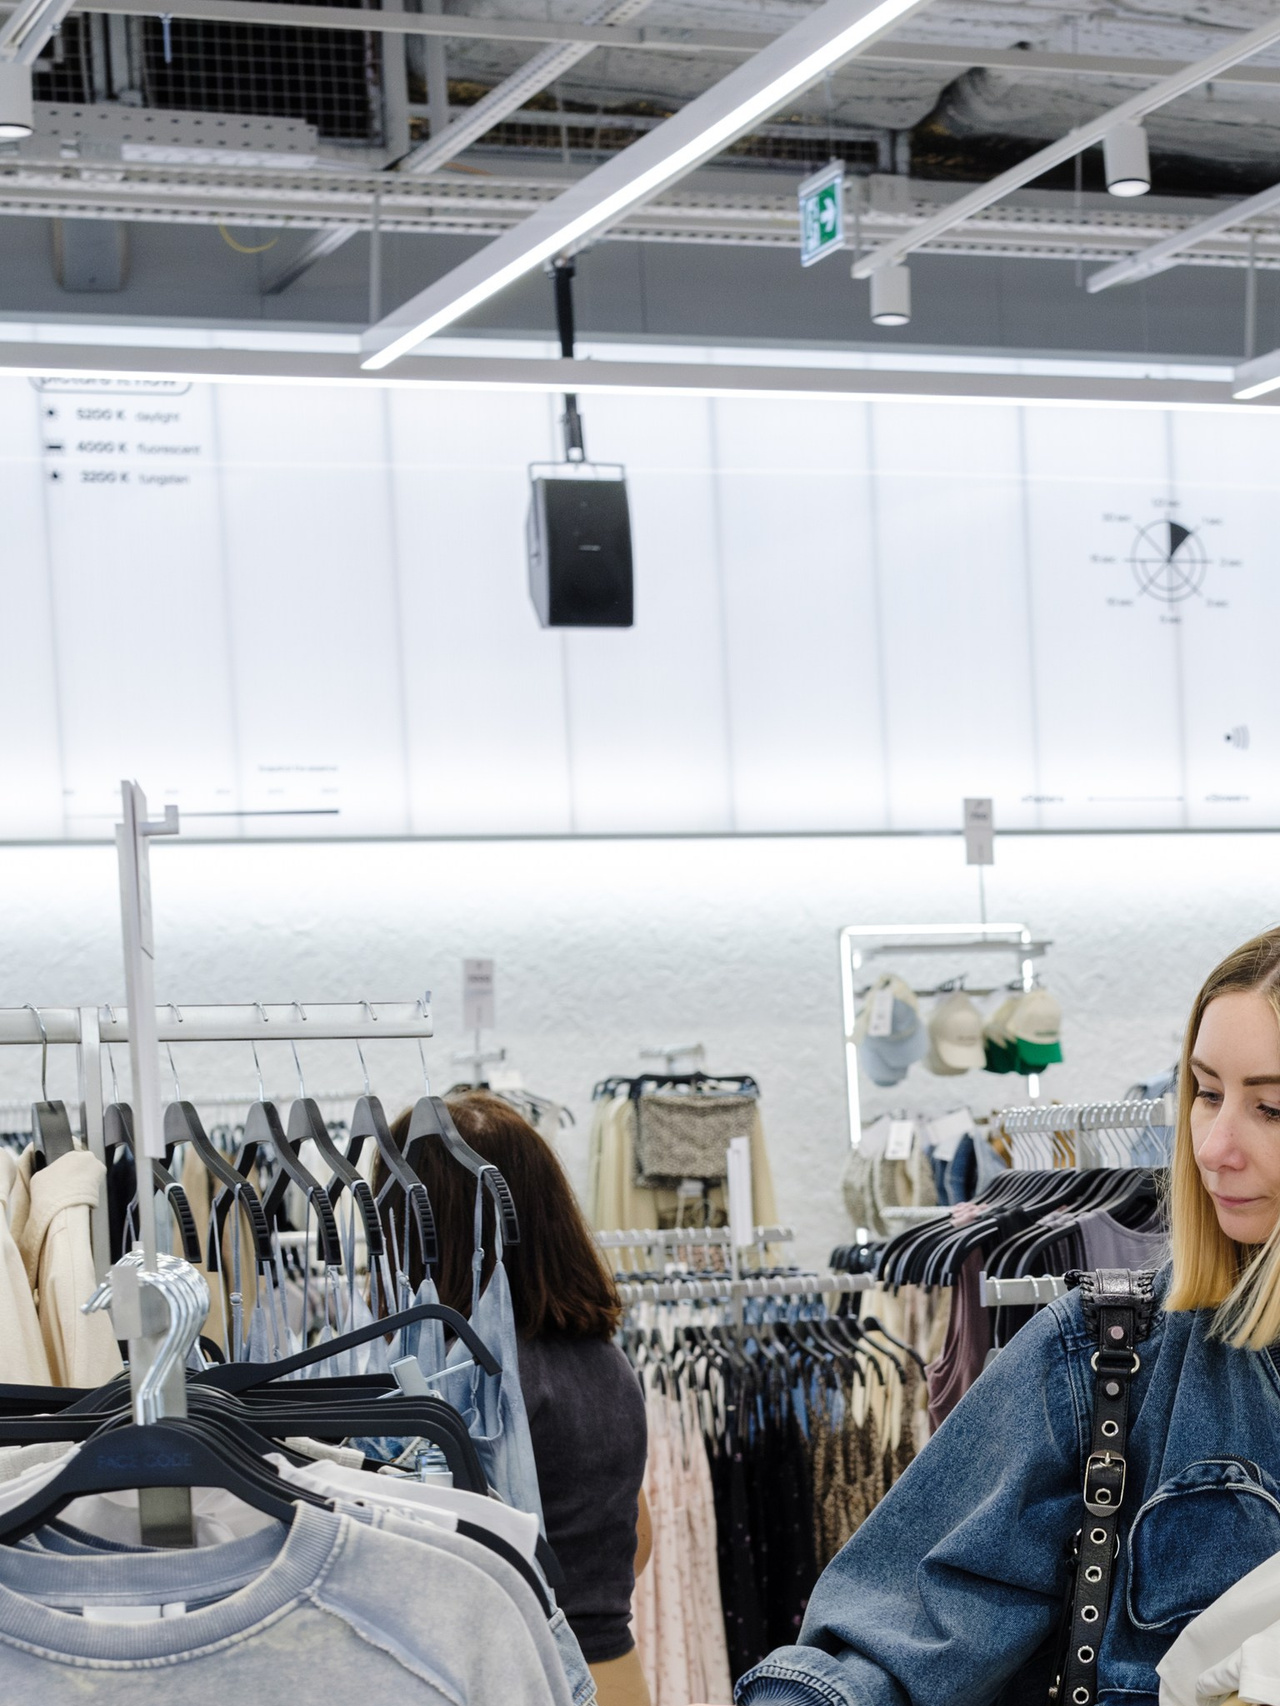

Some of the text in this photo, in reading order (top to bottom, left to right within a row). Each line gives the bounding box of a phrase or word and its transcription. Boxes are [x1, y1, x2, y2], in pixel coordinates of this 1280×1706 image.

[76, 408, 180, 424] 5200 K daylight
[76, 440, 200, 455] 4000 K fluorescent
[80, 470, 190, 486] 3200 K tungsten
[97, 1453, 192, 1469] FACE CODE
